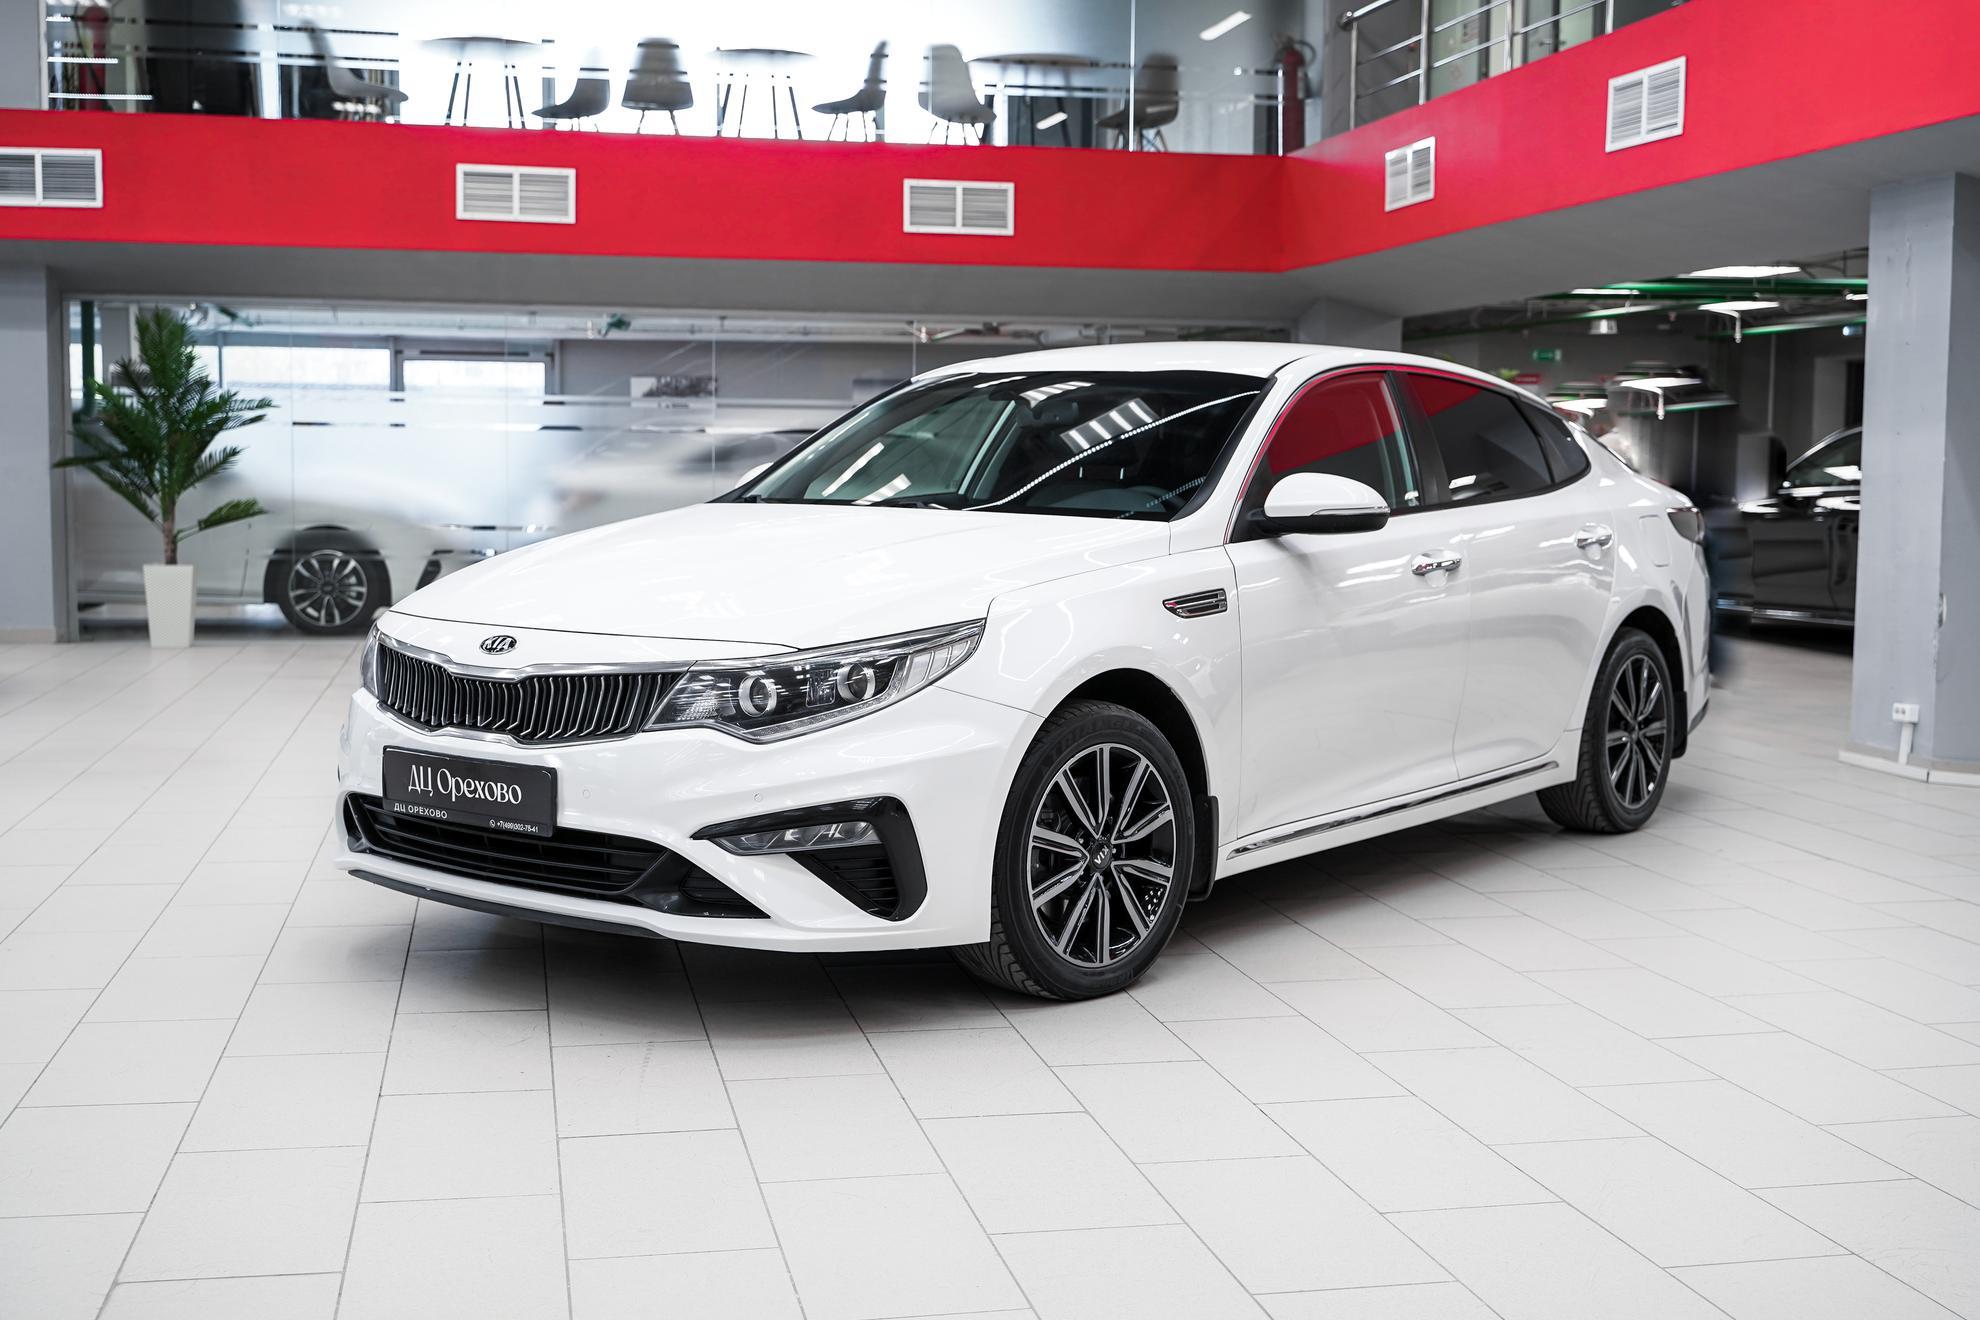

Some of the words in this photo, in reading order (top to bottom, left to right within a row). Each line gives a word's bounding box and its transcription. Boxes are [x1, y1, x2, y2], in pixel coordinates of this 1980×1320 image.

[482, 634, 513, 647] KIA
[408, 764, 434, 797] ДЦ
[437, 768, 522, 805] Орехово
[394, 802, 406, 813] ДЦ
[408, 804, 448, 819] ОРЕХОВО
[1094, 845, 1109, 865] KIA
